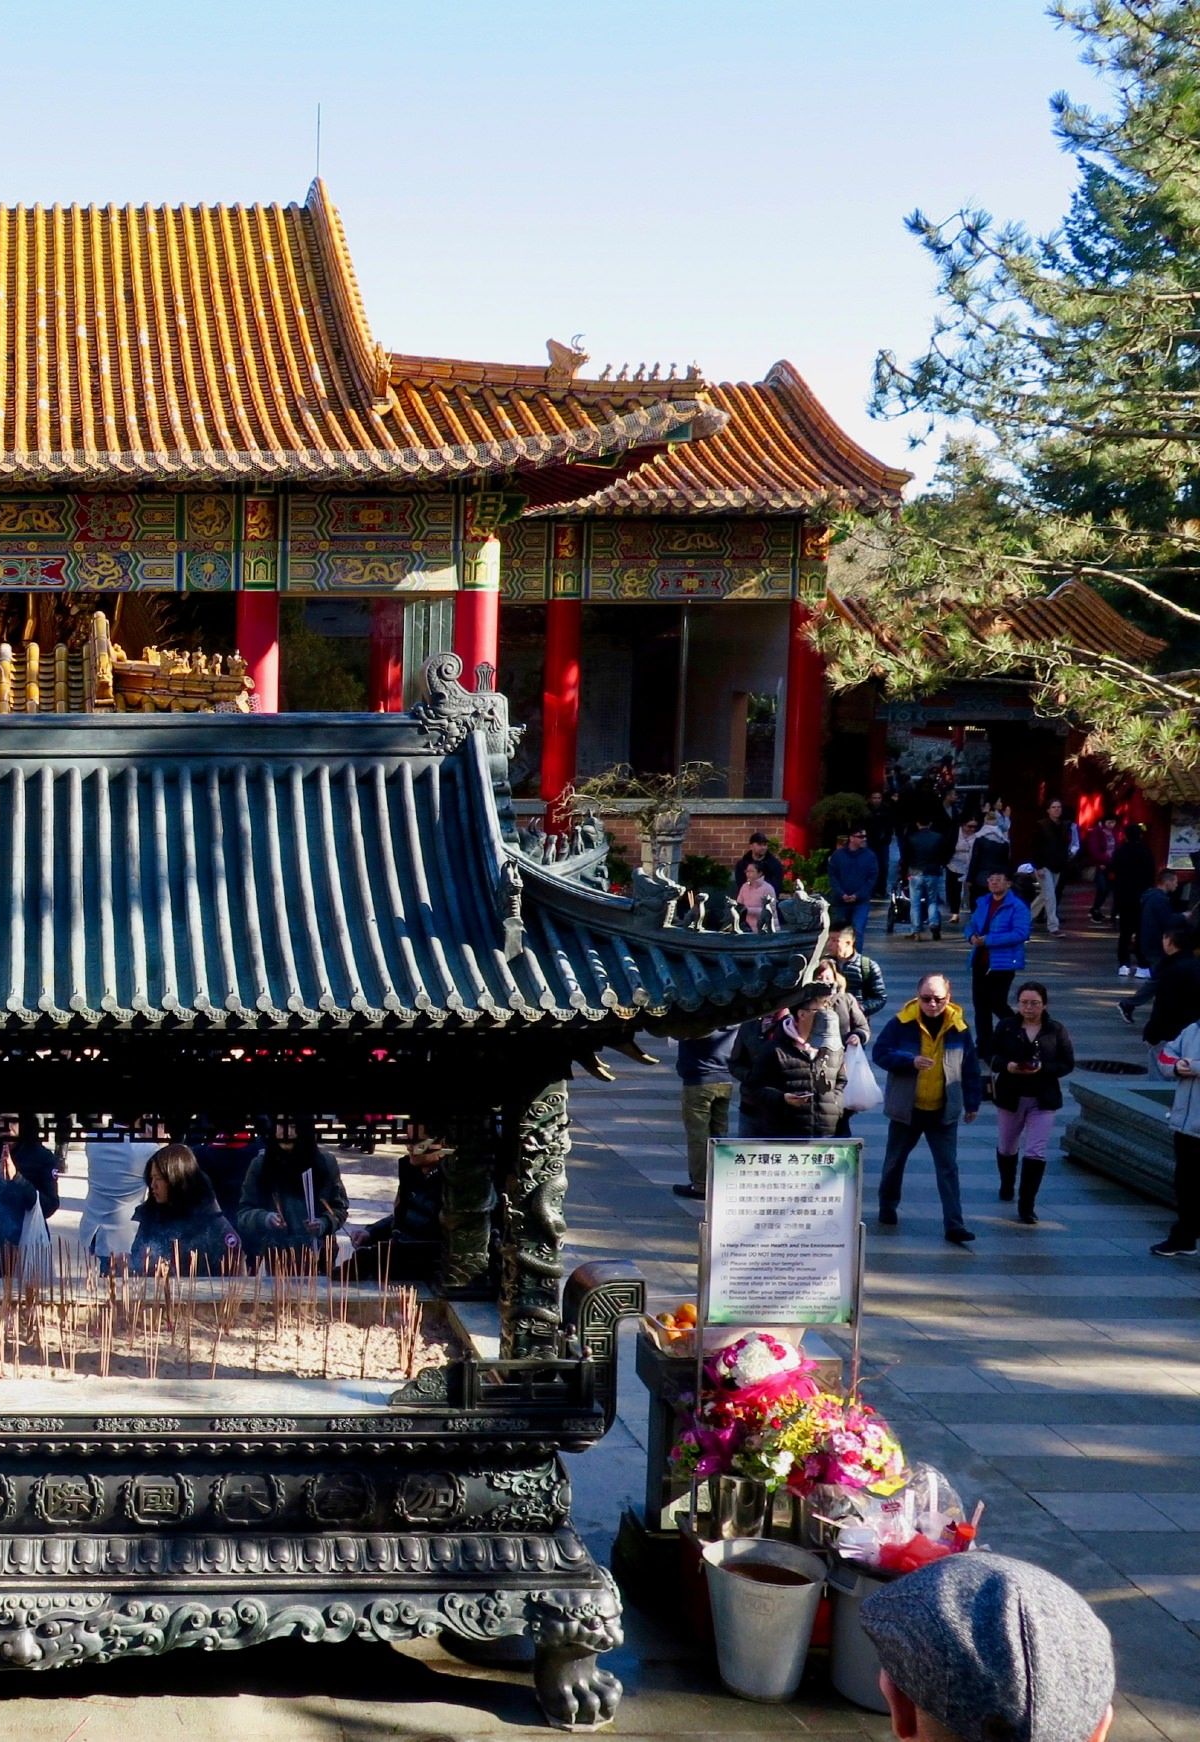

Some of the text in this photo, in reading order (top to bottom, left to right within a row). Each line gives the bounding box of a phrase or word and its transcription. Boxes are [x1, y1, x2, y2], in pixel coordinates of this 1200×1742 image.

[735, 1154, 834, 1165] 為了環保 為了健康
